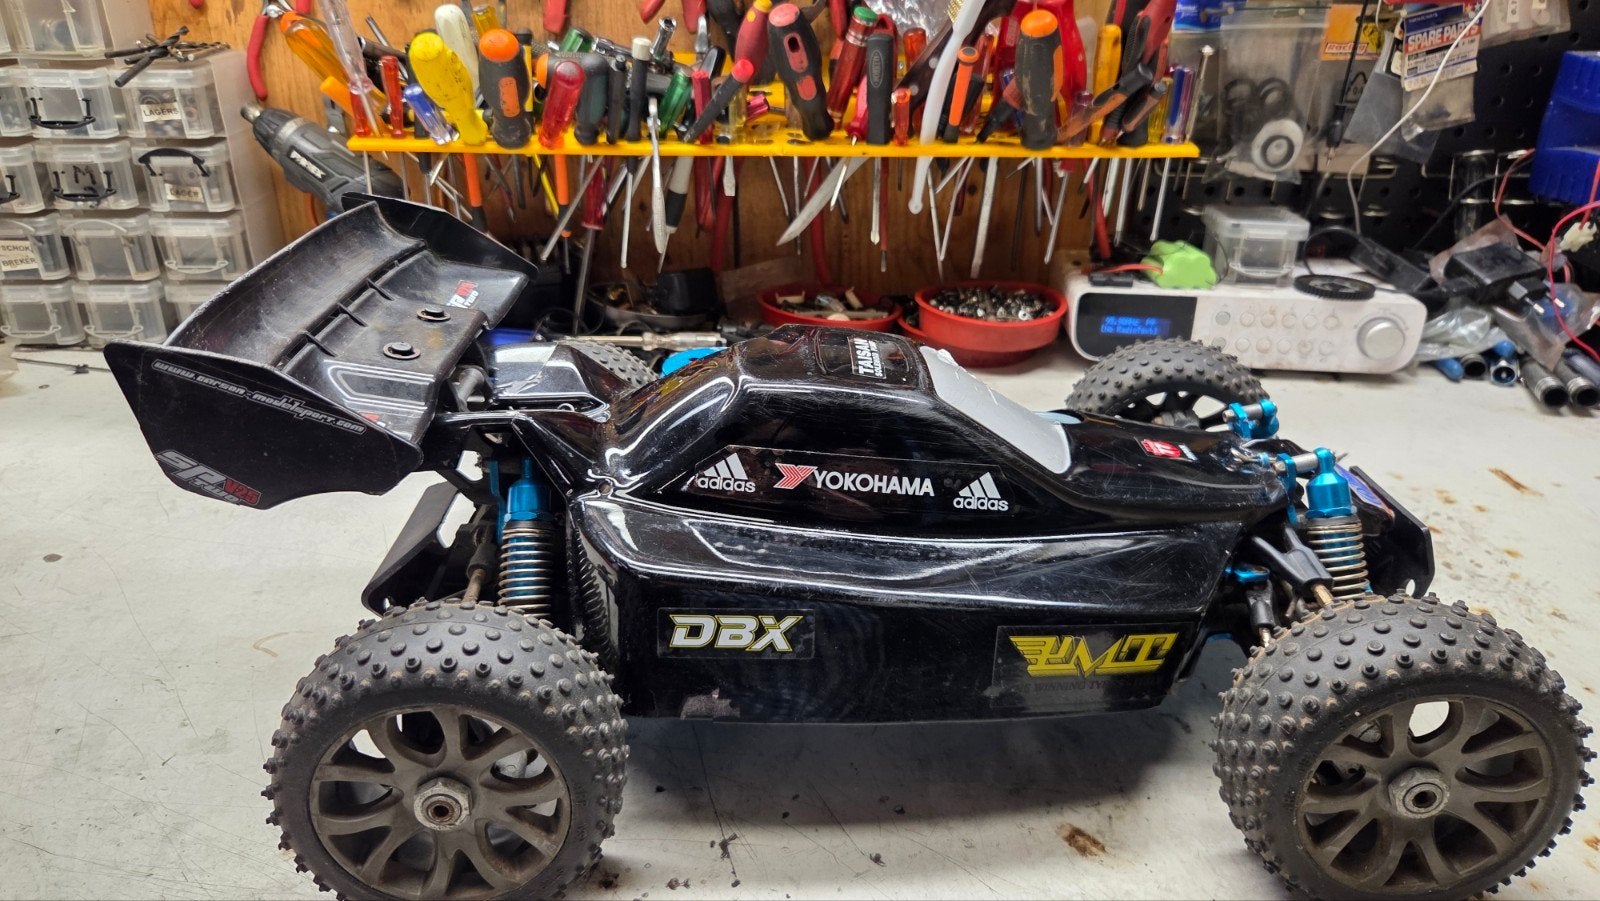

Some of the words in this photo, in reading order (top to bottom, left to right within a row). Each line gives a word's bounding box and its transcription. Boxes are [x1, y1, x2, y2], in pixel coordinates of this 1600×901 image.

[1407, 27, 1443, 51] SPARE
[143, 107, 179, 117] LAGERS
[853, 338, 874, 375] TAISAN
[697, 476, 756, 493] adidas
[814, 470, 935, 497] YOKOHAMA
[953, 495, 1009, 511] adidas
[669, 614, 803, 652] DBX
